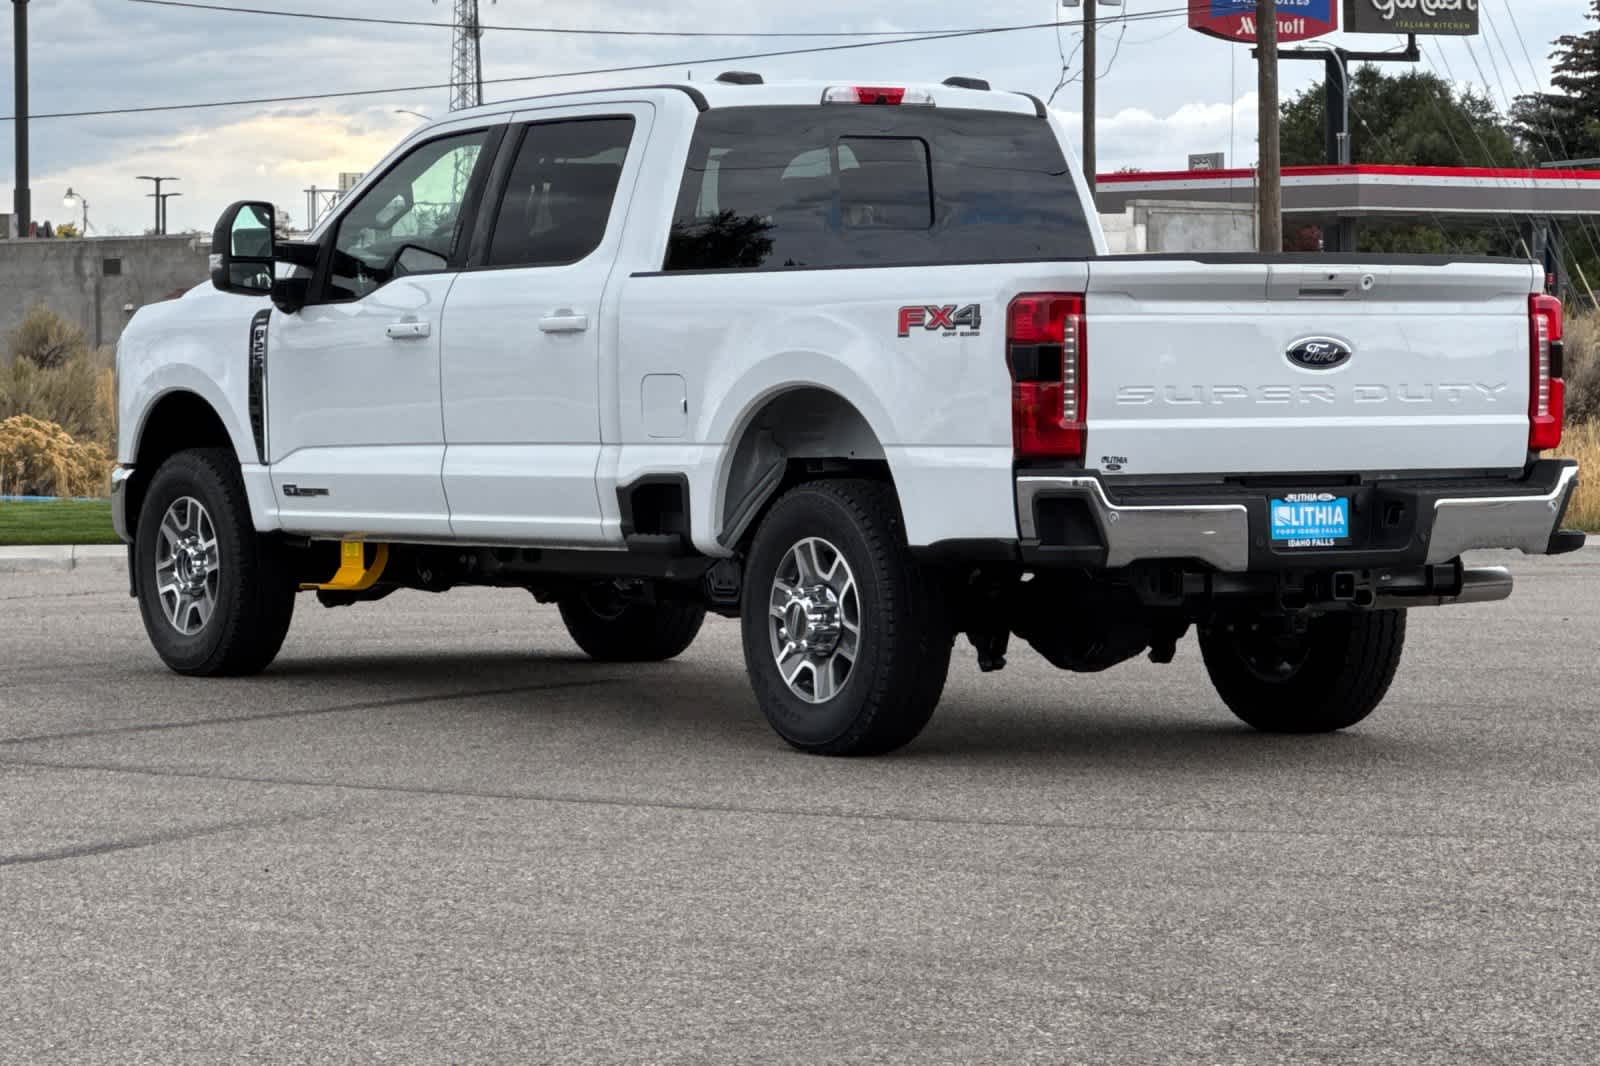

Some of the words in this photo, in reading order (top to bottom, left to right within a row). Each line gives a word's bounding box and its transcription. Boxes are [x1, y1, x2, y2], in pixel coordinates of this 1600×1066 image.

[1395, 21, 1430, 29] ITALIAN
[1433, 22, 1471, 30] KITCHEN
[897, 303, 982, 338] FX4
[1303, 343, 1338, 361] Ford
[1116, 384, 1336, 405] SUPER
[1352, 382, 1508, 404] DUTY
[1291, 505, 1345, 526] LITHIA
[1287, 539, 1311, 547] IDAHO
[1312, 538, 1335, 546] FALLS
